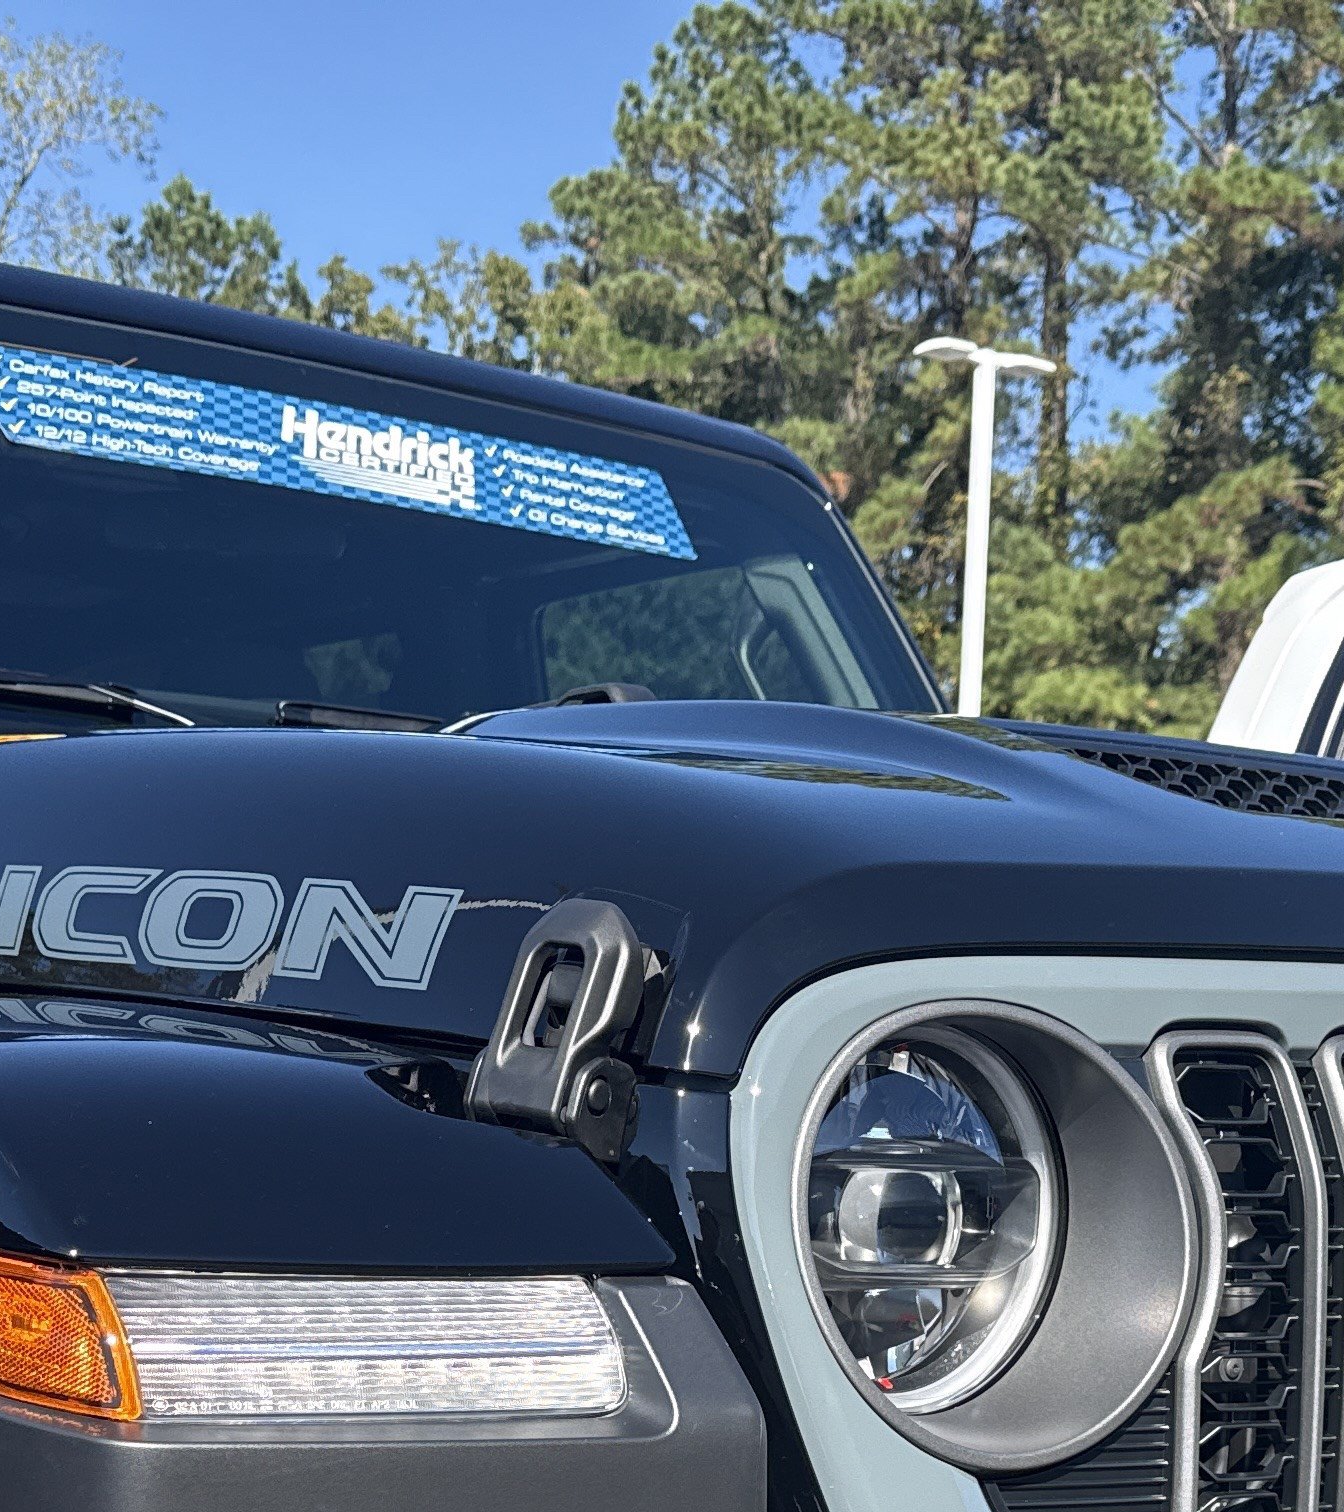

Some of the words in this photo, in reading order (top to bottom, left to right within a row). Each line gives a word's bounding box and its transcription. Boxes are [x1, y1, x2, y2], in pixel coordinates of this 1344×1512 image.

[9, 359, 70, 380] Carfax
[75, 369, 139, 393] History
[144, 381, 204, 402] Report
[27, 402, 92, 424] 10/100
[97, 412, 193, 440] Powertrain
[35, 424, 86, 444] 12/12
[280, 403, 475, 476] Hendrick
[318, 446, 476, 487] CERTIFIED
[512, 468, 540, 485] Trip
[520, 488, 566, 507] Rental
[550, 511, 604, 534] Change
